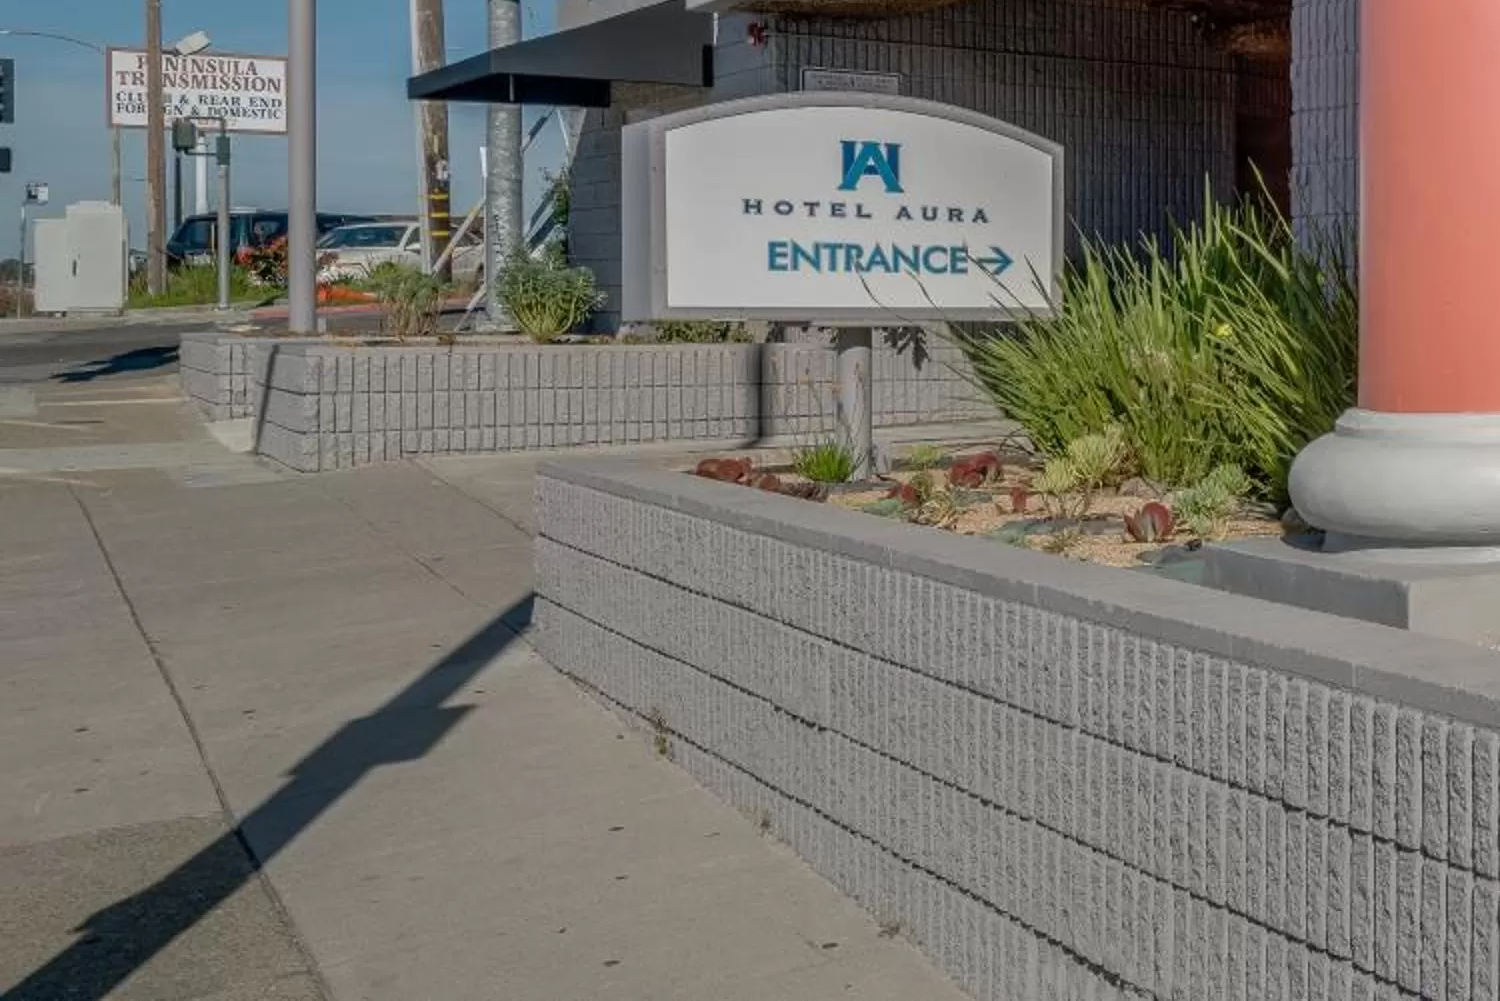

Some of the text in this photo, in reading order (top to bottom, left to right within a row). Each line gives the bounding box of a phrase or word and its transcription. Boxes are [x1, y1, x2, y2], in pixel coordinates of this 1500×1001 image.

[116, 71, 281, 93] TRNSMISSION
[116, 103, 183, 115] FORGN
[207, 106, 282, 119] DOMESTIC
[199, 94, 241, 106] REAR
[249, 97, 282, 108] END
[742, 198, 989, 224] HOTEL AURA
[767, 239, 968, 275] ENTRANCE
